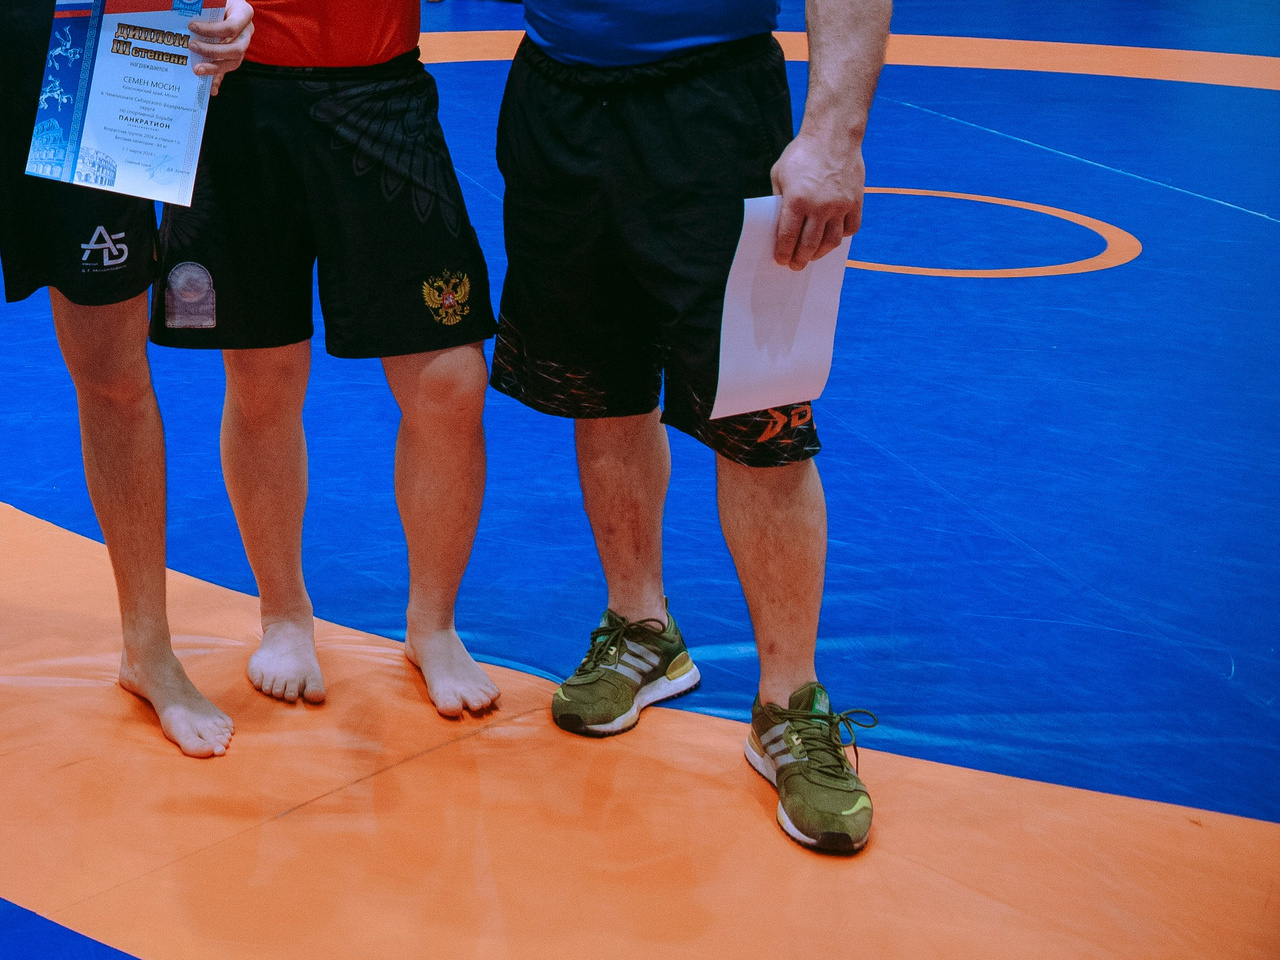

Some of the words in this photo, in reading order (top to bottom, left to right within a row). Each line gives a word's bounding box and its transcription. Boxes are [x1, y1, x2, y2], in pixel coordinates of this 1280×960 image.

[114, 22, 190, 49] ДИПЛОМ
[131, 46, 188, 65] степени
[123, 75, 148, 86] СЕМЕН
[150, 81, 180, 92] МОСИН
[118, 114, 170, 129] ПАНКРАТИОН
